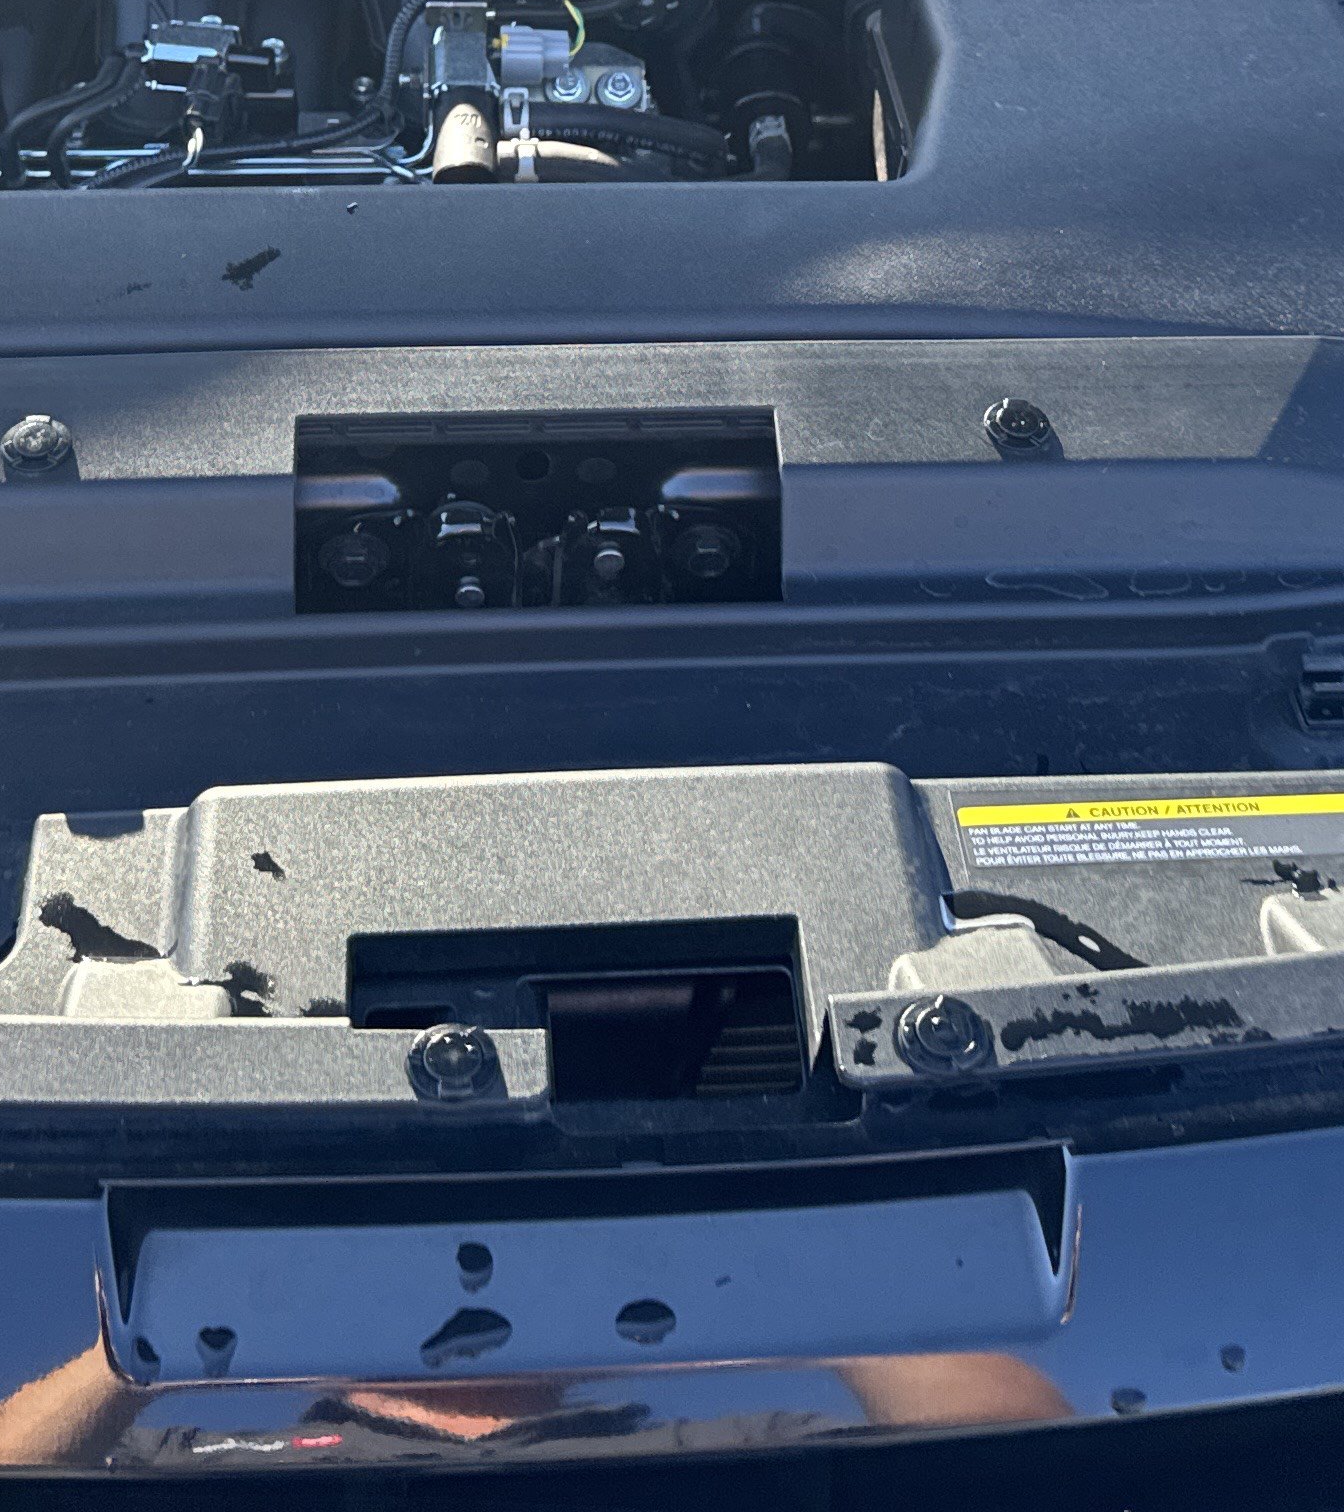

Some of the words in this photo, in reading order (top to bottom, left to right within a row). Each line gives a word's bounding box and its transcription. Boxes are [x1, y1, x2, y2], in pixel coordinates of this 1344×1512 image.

[1089, 805, 1159, 818] CAUTION
[1165, 806, 1170, 815] /
[1177, 802, 1260, 815] ATTENTION
[968, 827, 988, 836] FAN
[990, 826, 1022, 835] BLADE
[1024, 825, 1046, 834] CAN
[1048, 824, 1077, 833] START
[1080, 823, 1091, 832] AT
[1094, 822, 1113, 831] ANY
[1116, 821, 1140, 831] TIME.
[971, 837, 984, 845] TO
[987, 835, 1012, 844] HELP
[1015, 834, 1044, 843] AVOID
[1046, 832, 1099, 842] PERSONAL
[1135, 829, 1160, 838] KEEP
[1161, 828, 1197, 838] HANDS
[1198, 827, 1233, 836] CLEAR.
[973, 847, 986, 856] LE
[988, 845, 1052, 855] VENTILATEUR
[1053, 843, 1091, 852] RISQUE
[1092, 842, 1105, 851] DE
[1108, 840, 1162, 851] DÉMARRER
[1173, 839, 1199, 848] TOUT
[1201, 837, 1246, 847] MOMENT.
[976, 856, 1005, 866] POUR
[1007, 853, 1041, 865] ÉVITER
[1042, 854, 1074, 863] TOUTE
[1132, 851, 1147, 860] NE
[1148, 850, 1168, 860] PAS
[1169, 849, 1184, 858] EN
[1186, 847, 1248, 858] APPROCHER
[1248, 846, 1267, 856] LES
